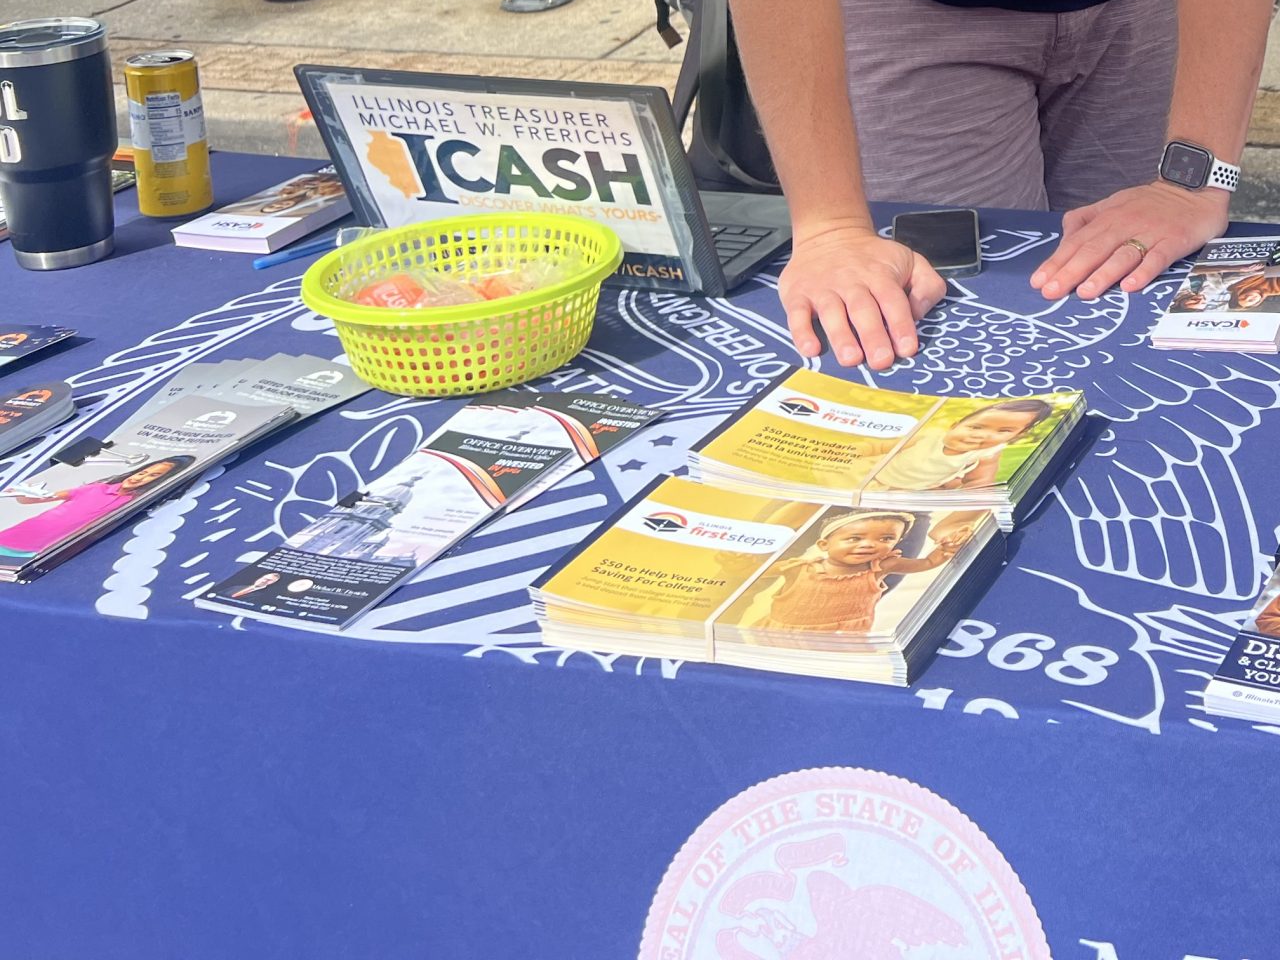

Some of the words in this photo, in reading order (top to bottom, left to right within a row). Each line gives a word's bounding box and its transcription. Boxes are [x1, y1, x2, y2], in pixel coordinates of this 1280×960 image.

[352, 95, 455, 117] ILLINOIS
[464, 104, 609, 129] TREASURER
[358, 112, 467, 136] MICHAEL
[475, 122, 502, 138] W.
[514, 124, 633, 147] FRERICHS
[390, 131, 653, 207] ICASH
[457, 193, 542, 214] DISCOVER
[538, 201, 597, 220] WHAT'S
[1207, 251, 1271, 260] COVER
[571, 397, 608, 411] OFFICE
[605, 402, 661, 417] OVERVIEW
[596, 417, 642, 430] INVESTED
[761, 424, 784, 437] $50
[781, 429, 809, 443] para
[821, 409, 904, 434] firststeps
[462, 436, 501, 451] OFFICE
[497, 441, 563, 458] OVERVIEW
[747, 438, 774, 452] para
[773, 443, 786, 453] la
[785, 447, 854, 466] universidad.
[763, 434, 811, 452] empezar
[811, 445, 820, 453] a
[819, 447, 863, 460] ahorrar
[494, 458, 546, 471] INVESTED
[689, 525, 777, 547] firststeps
[591, 566, 634, 583] Saving
[634, 575, 658, 586] For
[656, 579, 704, 593] College
[599, 557, 624, 571] $50
[624, 564, 637, 573] to
[639, 567, 668, 580] Help
[670, 572, 693, 583] You
[694, 576, 727, 587] Start
[1237, 655, 1250, 667] &
[664, 902, 697, 960] EAL
[692, 846, 728, 892] OF
[731, 798, 803, 848] THE
[815, 792, 924, 838] STATE
[932, 834, 977, 874] OF
